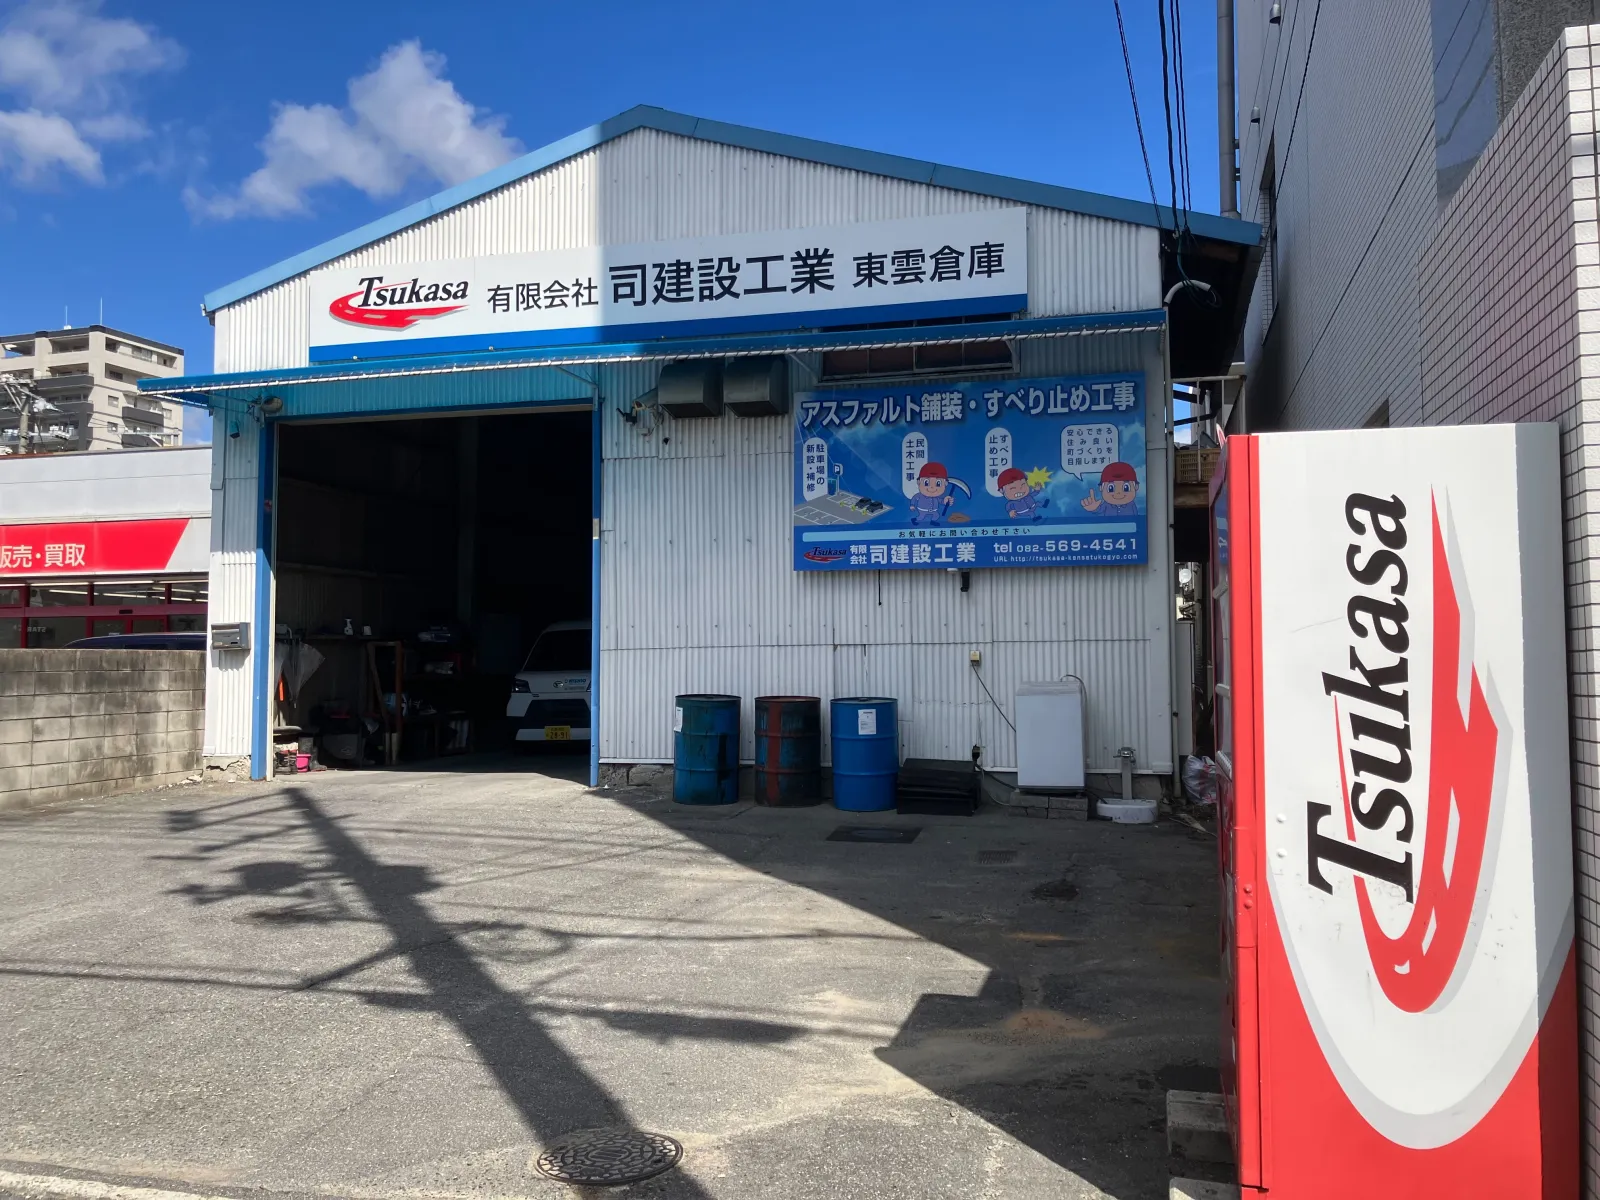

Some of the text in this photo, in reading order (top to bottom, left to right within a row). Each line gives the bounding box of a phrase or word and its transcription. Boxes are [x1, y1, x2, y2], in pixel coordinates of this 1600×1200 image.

[487, 242, 1005, 313] 有限会社 司建設工業 東雲倉庫
[357, 276, 469, 308] Tsukasa
[801, 381, 1136, 427] アスファルト舗装・すべり止め工事
[1066, 427, 1113, 437] 安心できる
[1066, 437, 1113, 447] 住み良い
[915, 438, 925, 459] 民間
[988, 434, 999, 478] 止め工事
[999, 434, 1009, 467] すべり
[1066, 447, 1113, 456] 町づくりを
[806, 444, 815, 492] 新設・補修
[816, 444, 825, 485] 駐車場の
[905, 439, 915, 482] 土木工事
[898, 528, 1031, 538] お気軽にお問い合わせ下さい
[812, 546, 847, 557] Tsukasa
[850, 544, 867, 555] 有限
[869, 542, 976, 565] 司建設工業
[993, 538, 1137, 553] tel 082-569-4541
[850, 555, 867, 565] 会社
[1307, 492, 1415, 905] Tsukasa
